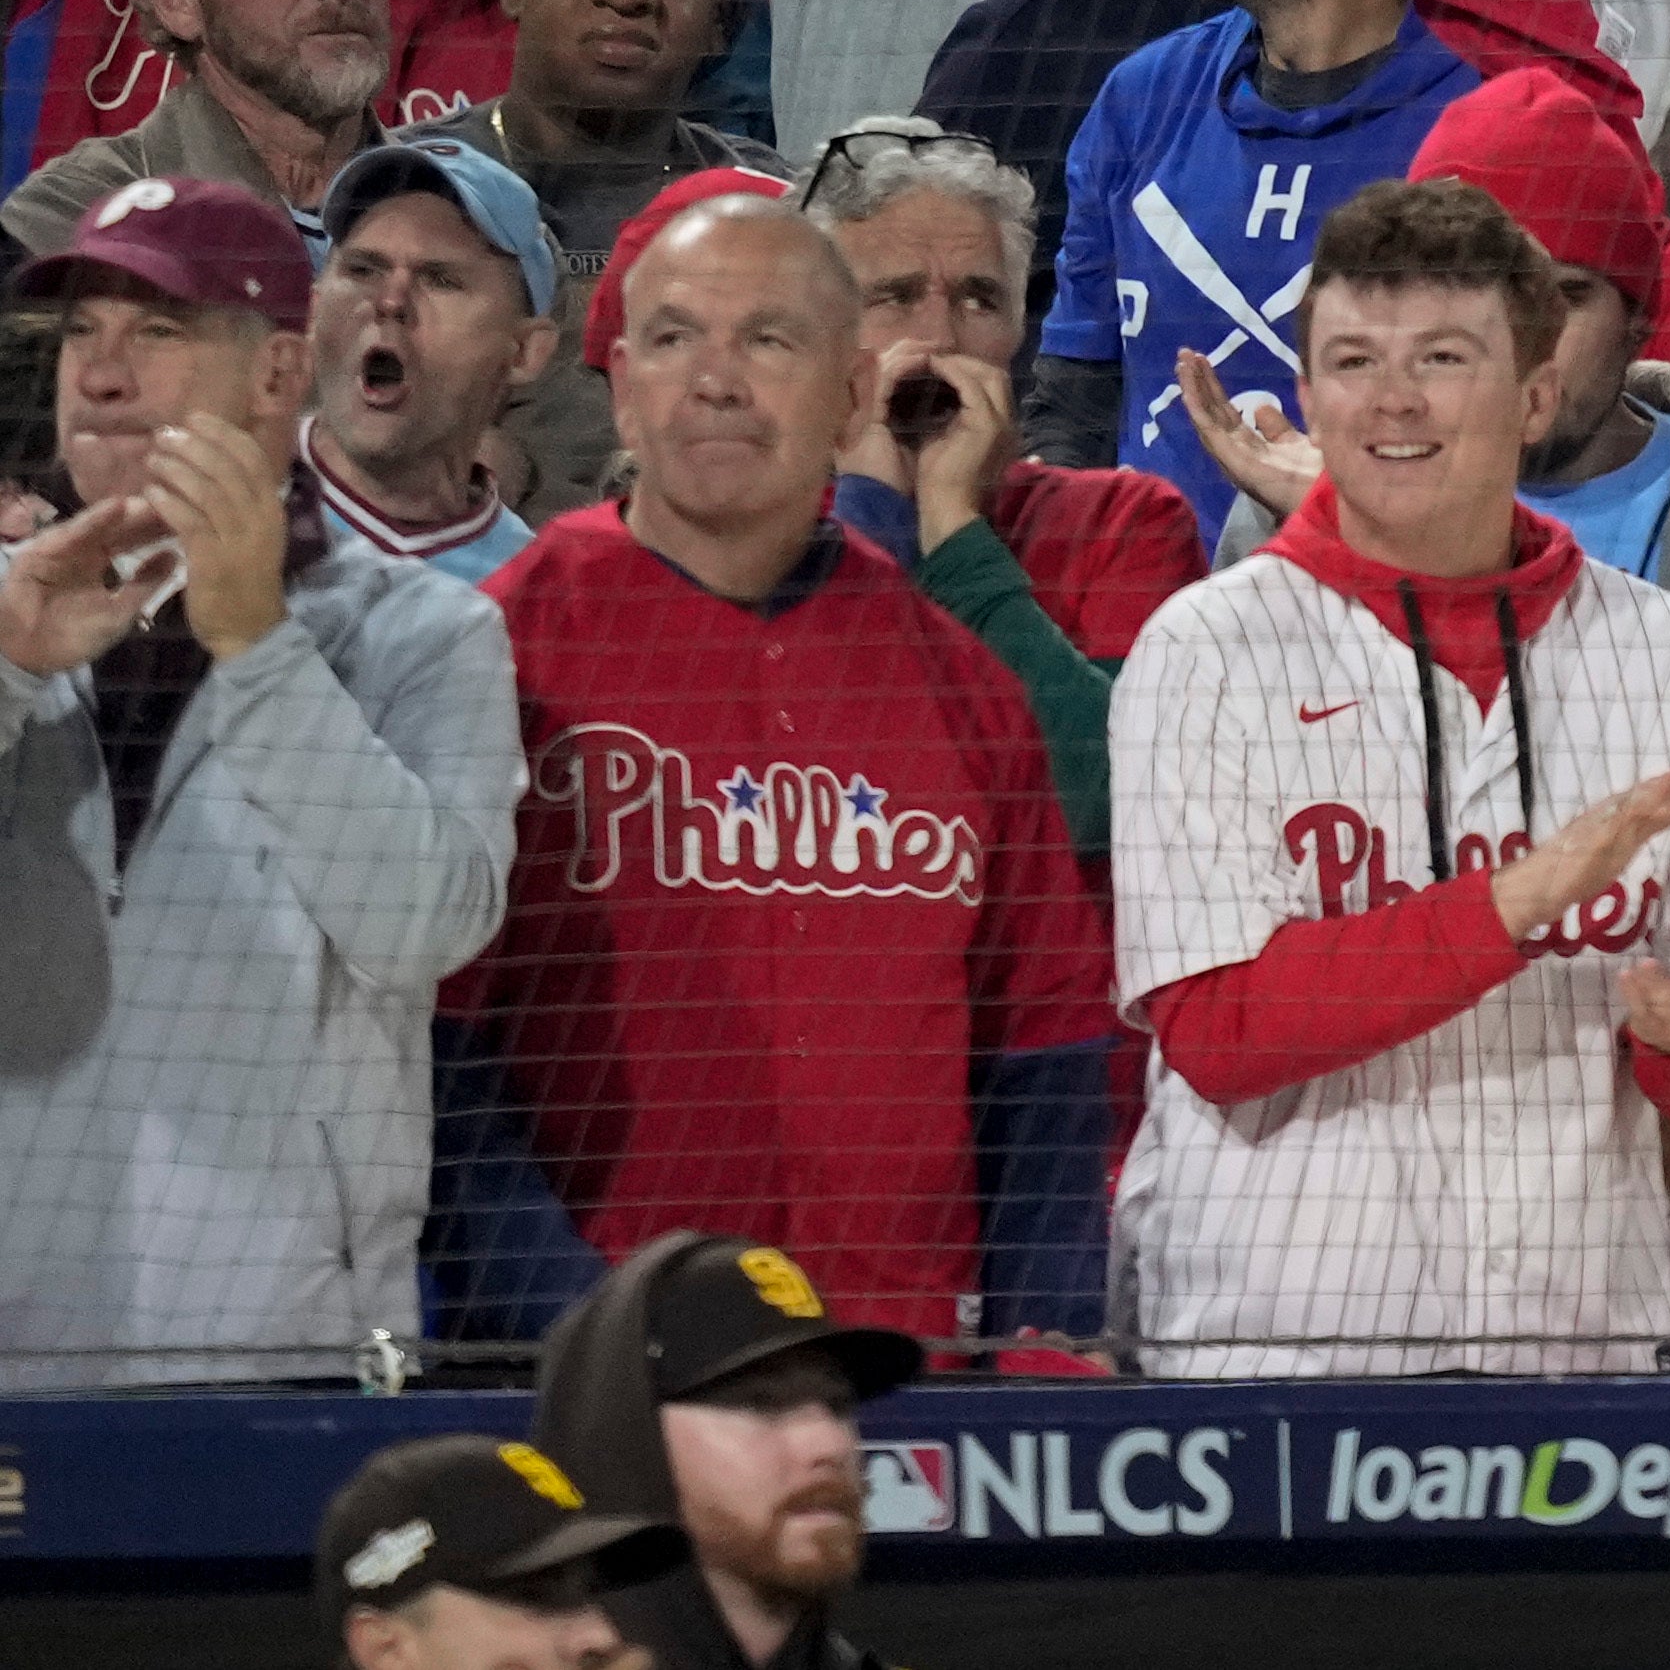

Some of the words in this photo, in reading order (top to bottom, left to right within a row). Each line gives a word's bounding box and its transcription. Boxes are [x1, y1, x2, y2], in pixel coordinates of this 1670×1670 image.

[95, 178, 176, 229] P
[534, 723, 985, 907] Phillies
[958, 1427, 1234, 1539] NLCS
